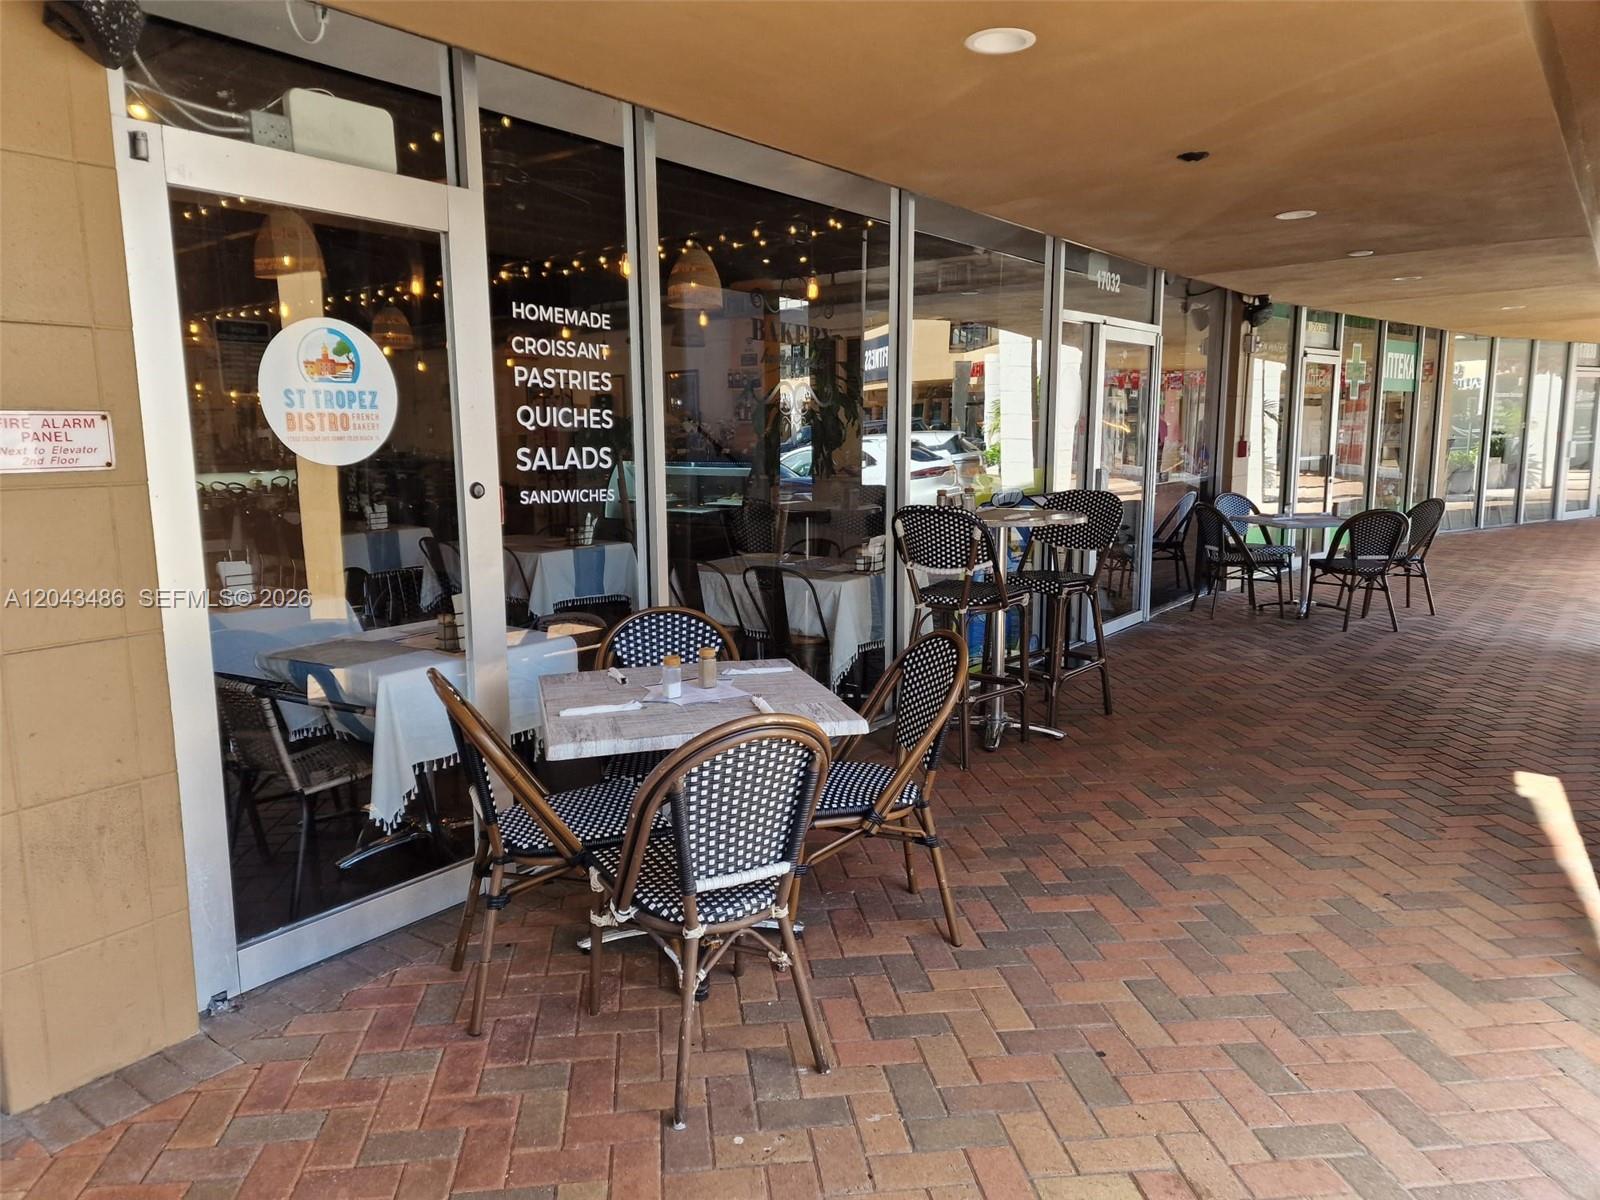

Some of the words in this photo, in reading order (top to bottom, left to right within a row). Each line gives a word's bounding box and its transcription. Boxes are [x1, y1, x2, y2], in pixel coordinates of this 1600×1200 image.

[1097, 270, 1120, 293] 17032
[512, 301, 612, 330] HOMEMADE
[511, 336, 610, 360] CROISSANT
[514, 366, 612, 391] PASTRIES
[283, 388, 306, 409] ST
[312, 389, 379, 410] TROPEZ
[0, 417, 31, 429] IRE
[41, 418, 96, 429] ALARM
[285, 412, 350, 432] BISTRO
[351, 412, 380, 421] FRENCH
[352, 422, 380, 431] BAKERY
[516, 405, 614, 431] QUICHES
[21, 431, 73, 442] PANEL
[0, 446, 27, 455] Next
[34, 446, 46, 455] to
[51, 445, 98, 455] Elevator
[516, 447, 612, 471] SALADS
[22, 456, 44, 466] 2nd
[50, 456, 80, 465] Floor
[520, 489, 615, 505] SANDWICHES
